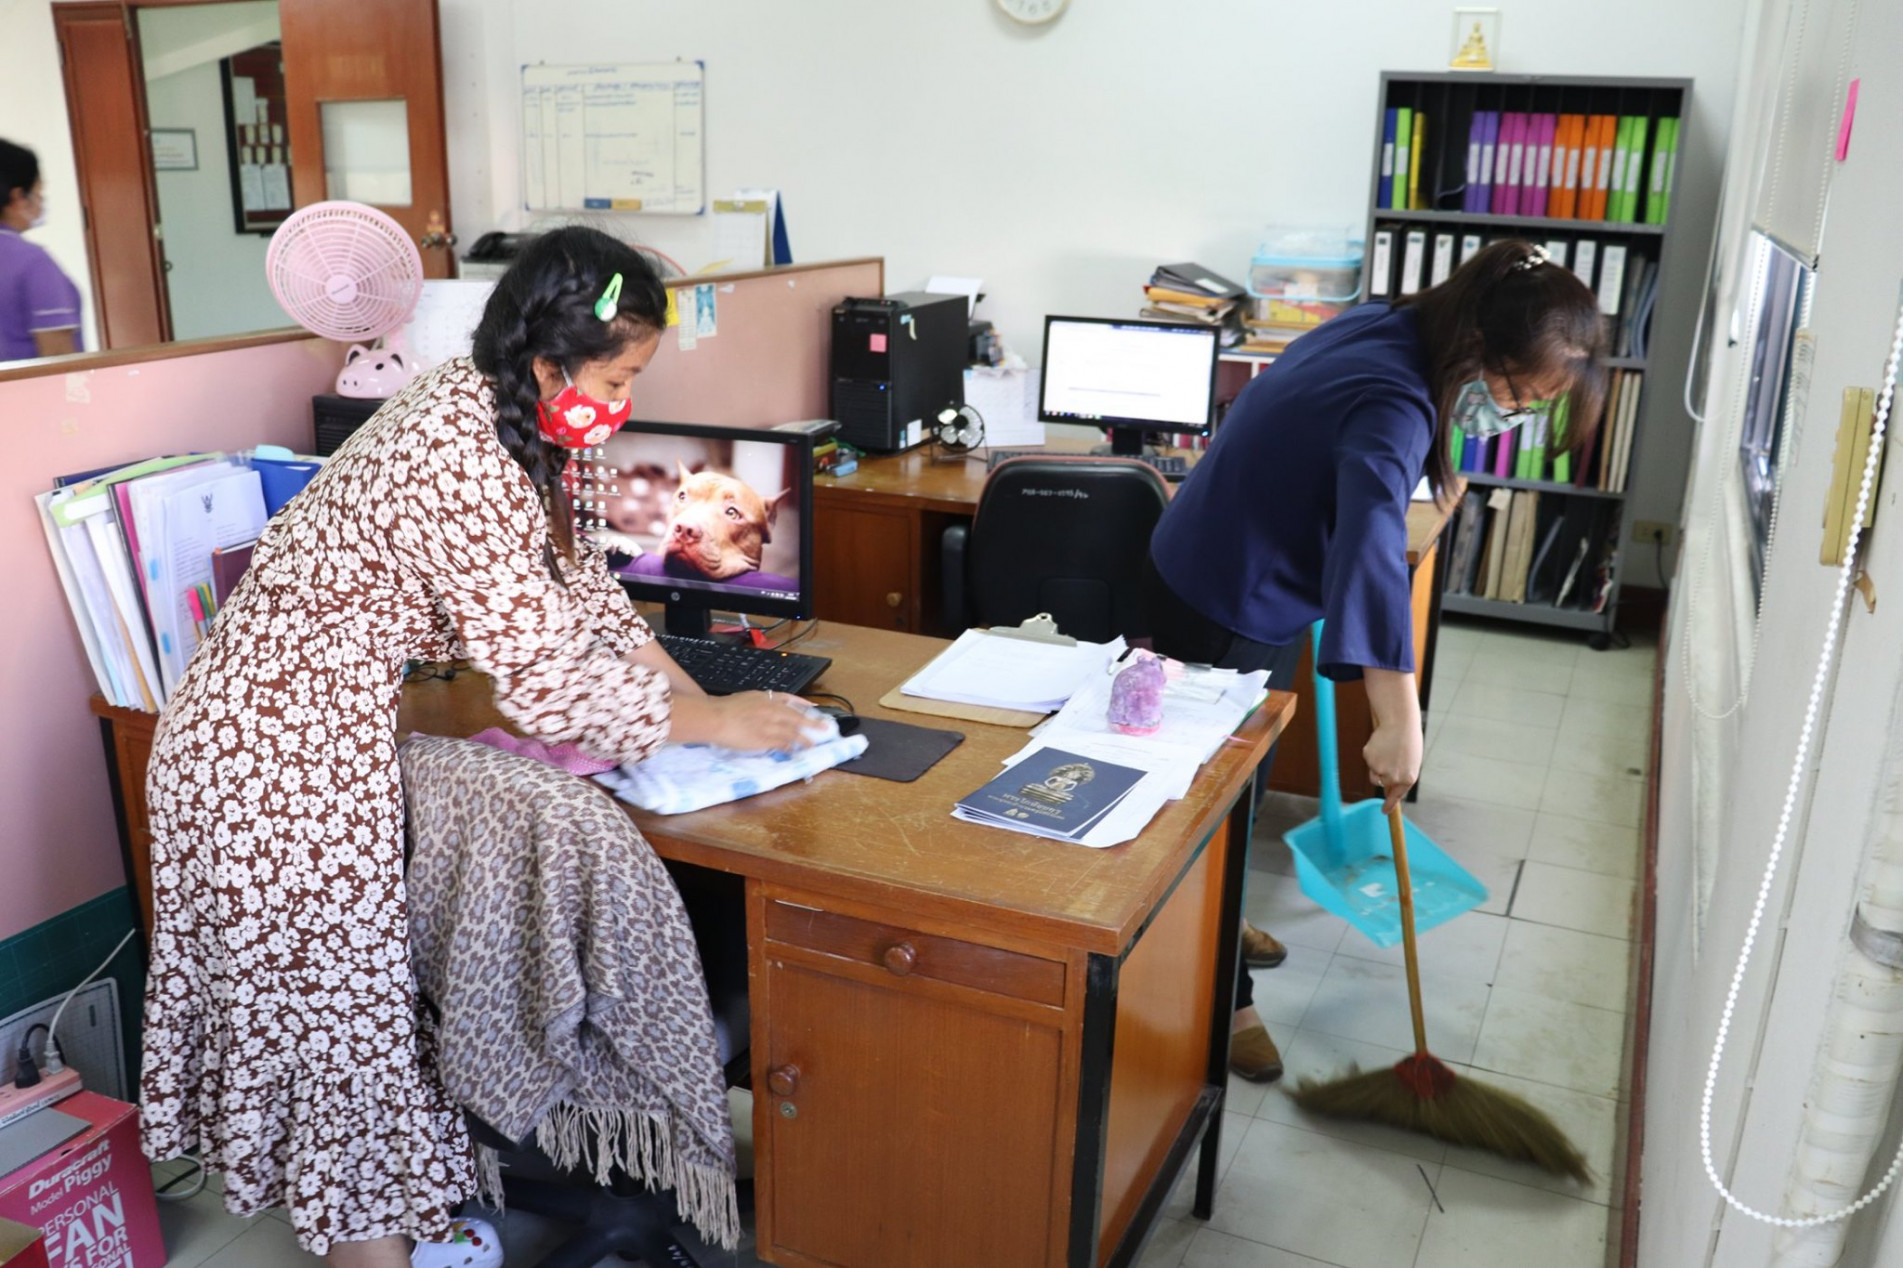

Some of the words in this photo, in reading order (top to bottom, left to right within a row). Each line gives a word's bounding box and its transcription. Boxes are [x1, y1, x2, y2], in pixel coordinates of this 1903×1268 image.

[29, 1139, 110, 1199] Duracraft
[31, 1187, 64, 1215] Model
[64, 1153, 112, 1193] Piggy
[85, 1226, 128, 1267] FOR
